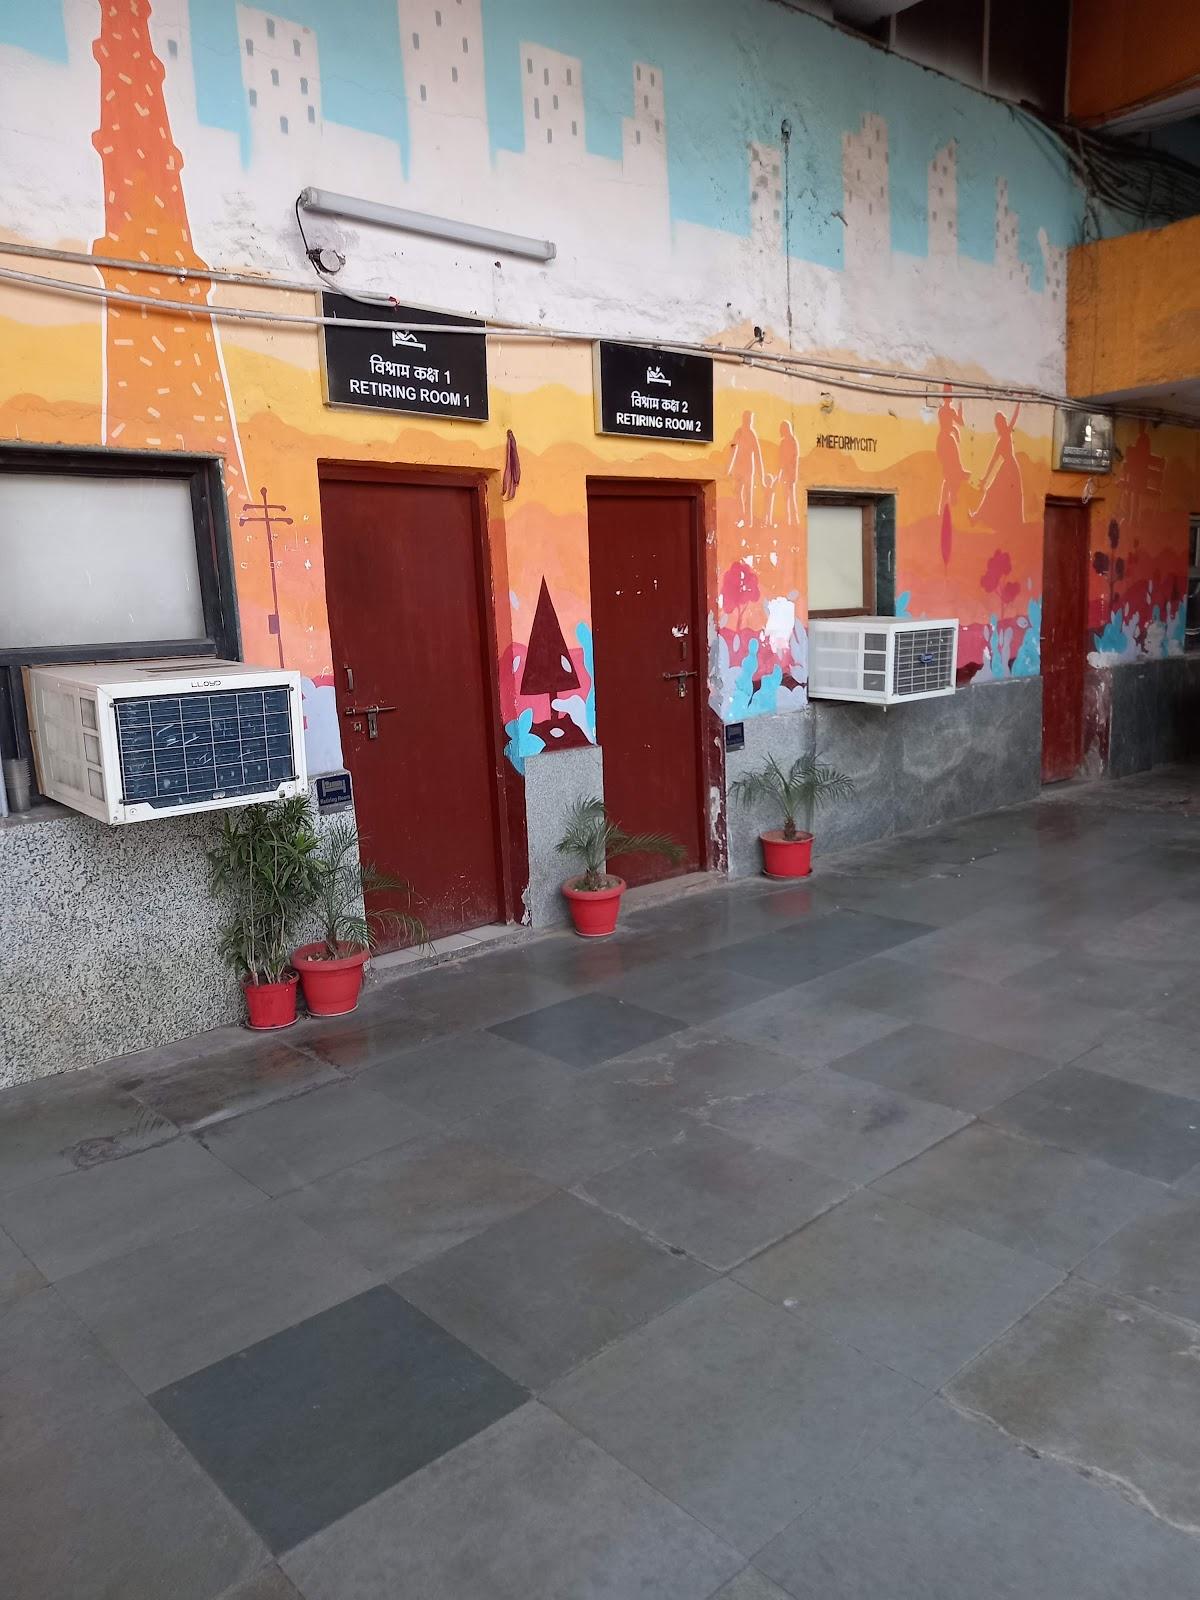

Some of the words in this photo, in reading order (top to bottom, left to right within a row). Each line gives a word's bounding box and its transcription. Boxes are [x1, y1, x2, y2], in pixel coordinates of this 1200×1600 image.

[370, 354, 410, 379] विश्राम
[414, 365, 439, 383] कक्ष
[444, 370, 451, 384] 1
[350, 379, 417, 401] RETIRING
[420, 389, 461, 406] ROOM
[464, 395, 470, 407] 1
[631, 391, 659, 410] विश्राम
[661, 399, 680, 413] कक्ष
[682, 401, 688, 413] 2
[616, 412, 663, 428] RETIRING
[665, 418, 693, 431] ROOM
[695, 421, 701, 432] 2
[191, 680, 221, 688] LLOYD
